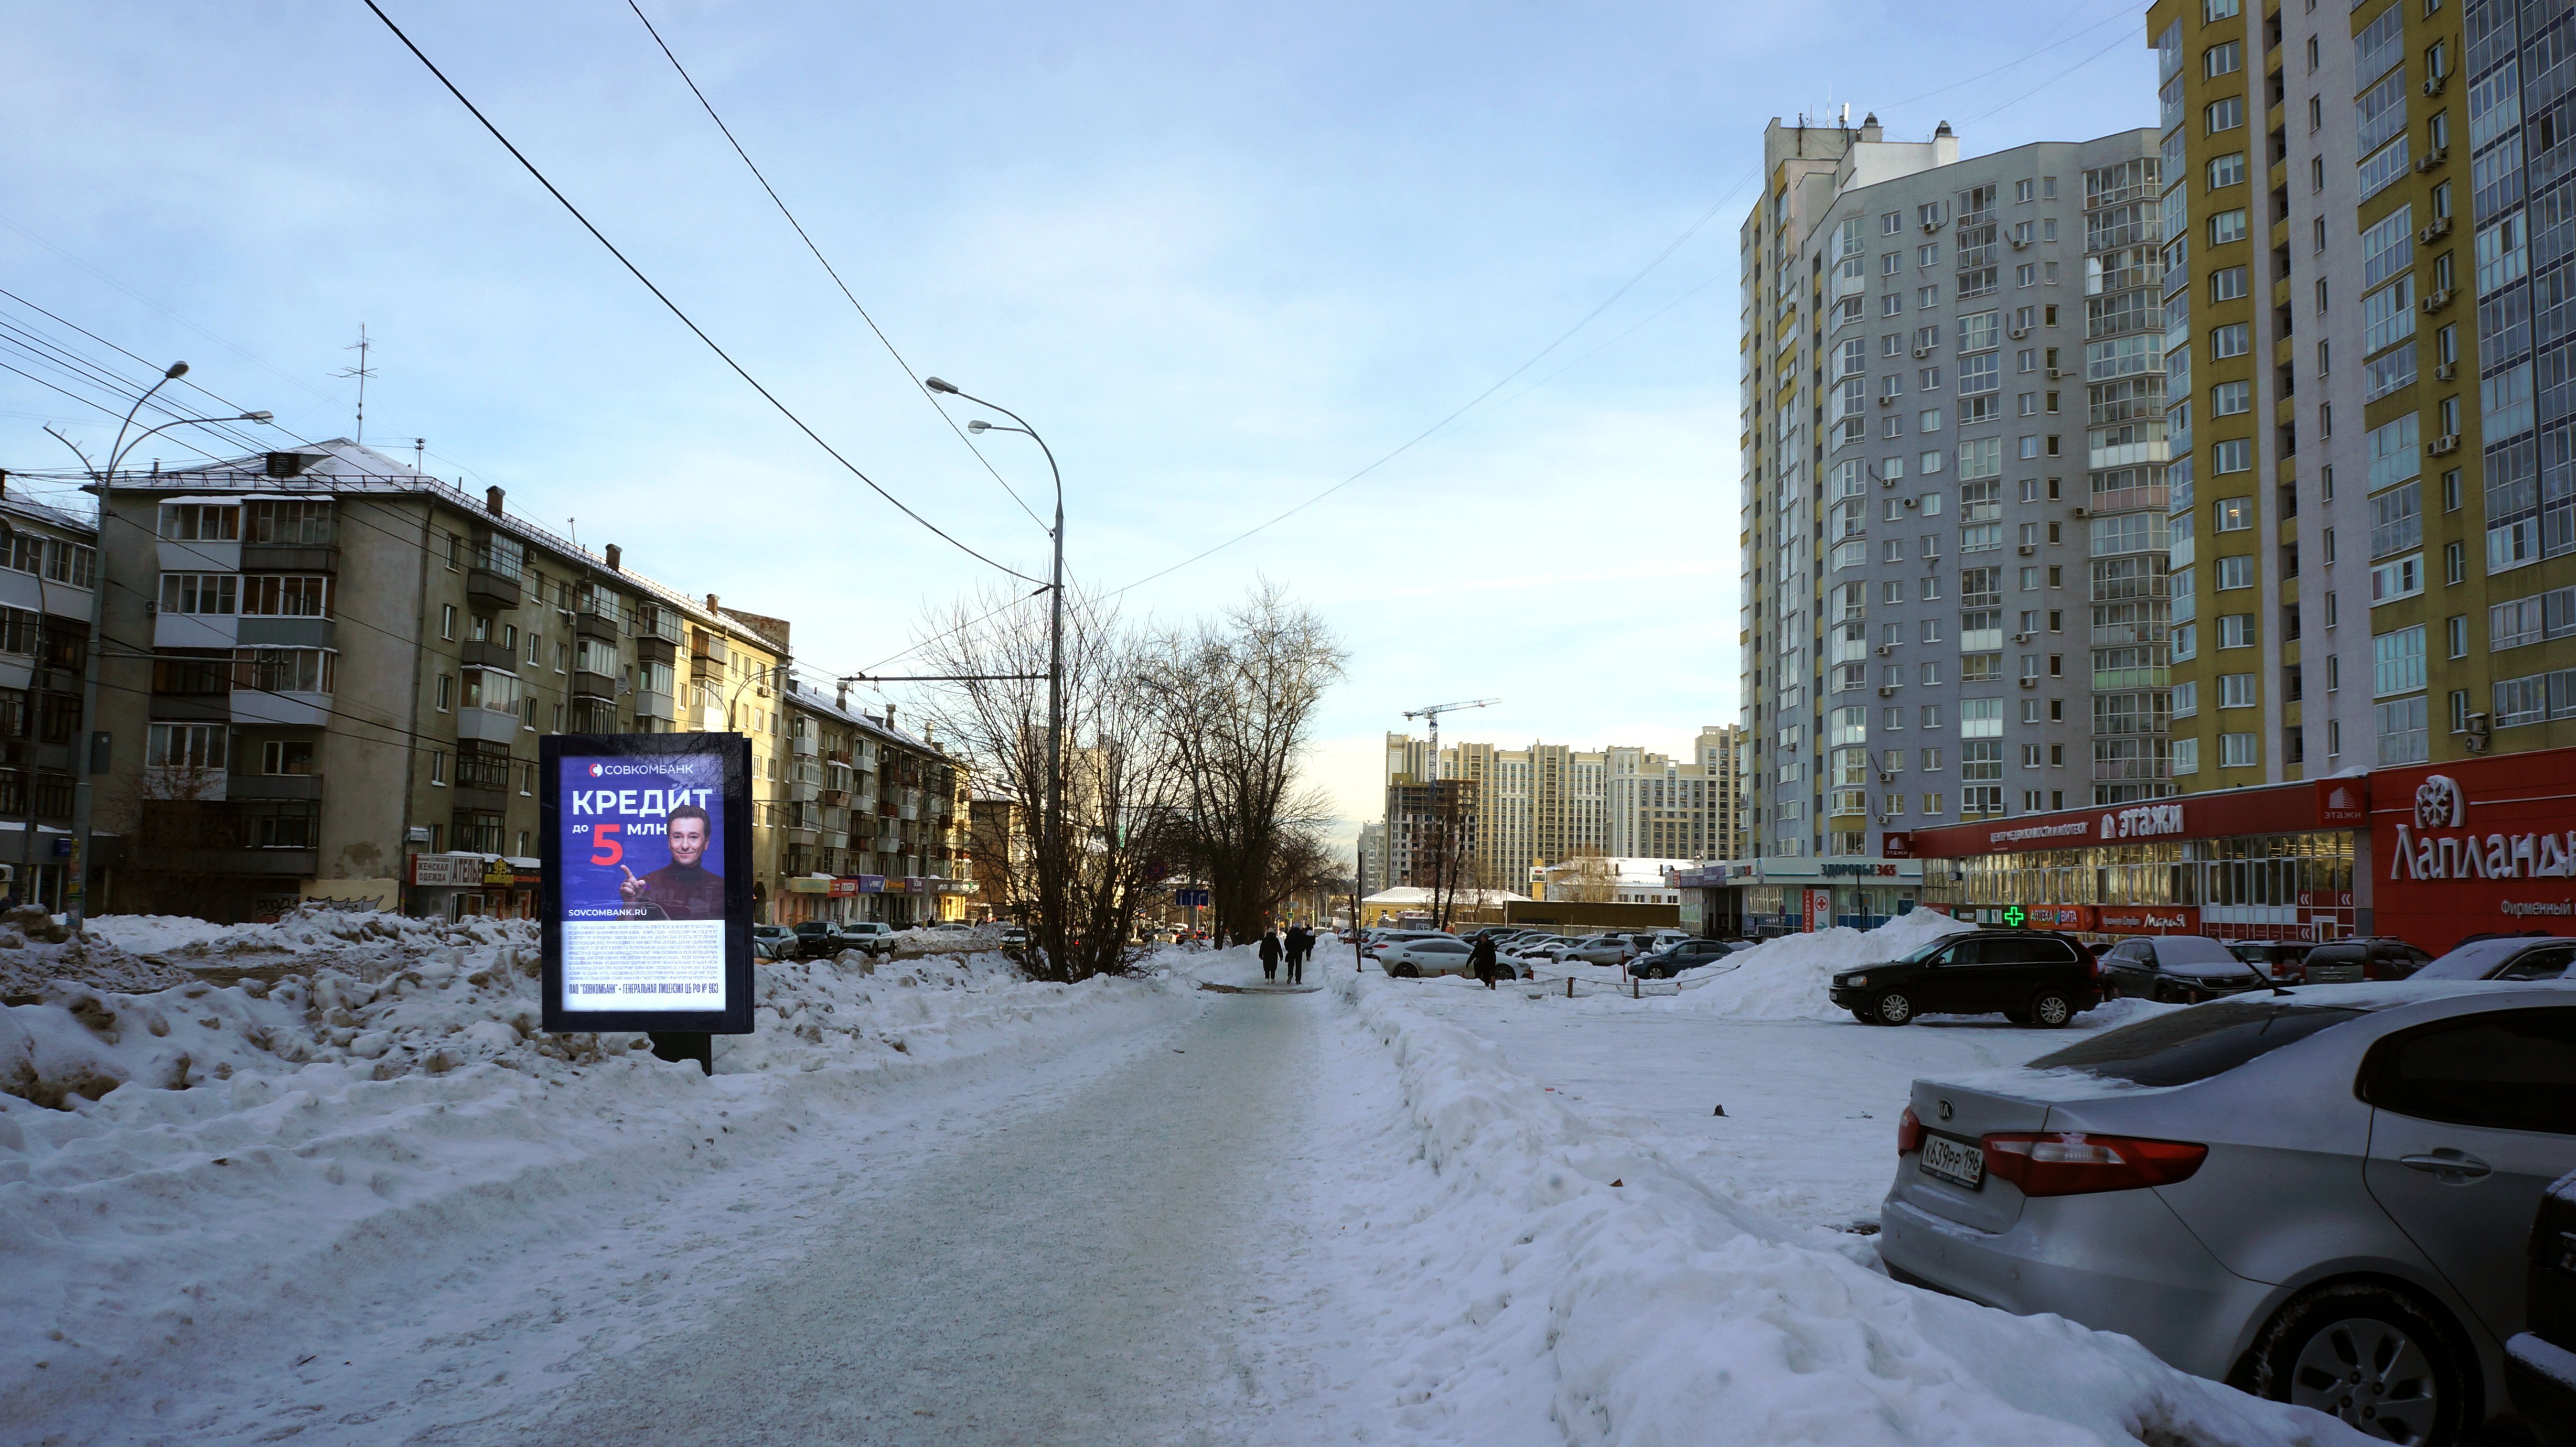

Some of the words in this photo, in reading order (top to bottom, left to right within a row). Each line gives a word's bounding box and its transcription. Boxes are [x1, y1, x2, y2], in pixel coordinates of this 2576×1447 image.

[605, 764, 694, 775] СОВКОМБАНК
[573, 789, 713, 817] КРЕДИТ
[590, 824, 623, 866] 5
[418, 862, 448, 871] ЖЕНСКАЯ
[452, 858, 482, 883] АТЕЛЬЕ
[420, 872, 446, 882] ОДЕЖДА
[2500, 898, 2570, 919] Фирменный
[2031, 910, 2053, 922] АПТЕКА
[2060, 910, 2077, 922] ВИТА
[569, 984, 578, 994] ПАО
[623, 983, 657, 994] ГЕНЕРАЛЬНАЯ
[658, 983, 683, 994] ЛИЦЕНЗИЯ
[685, 983, 692, 994] ЦБ
[693, 983, 701, 994] РФ
[709, 983, 718, 994] 963
